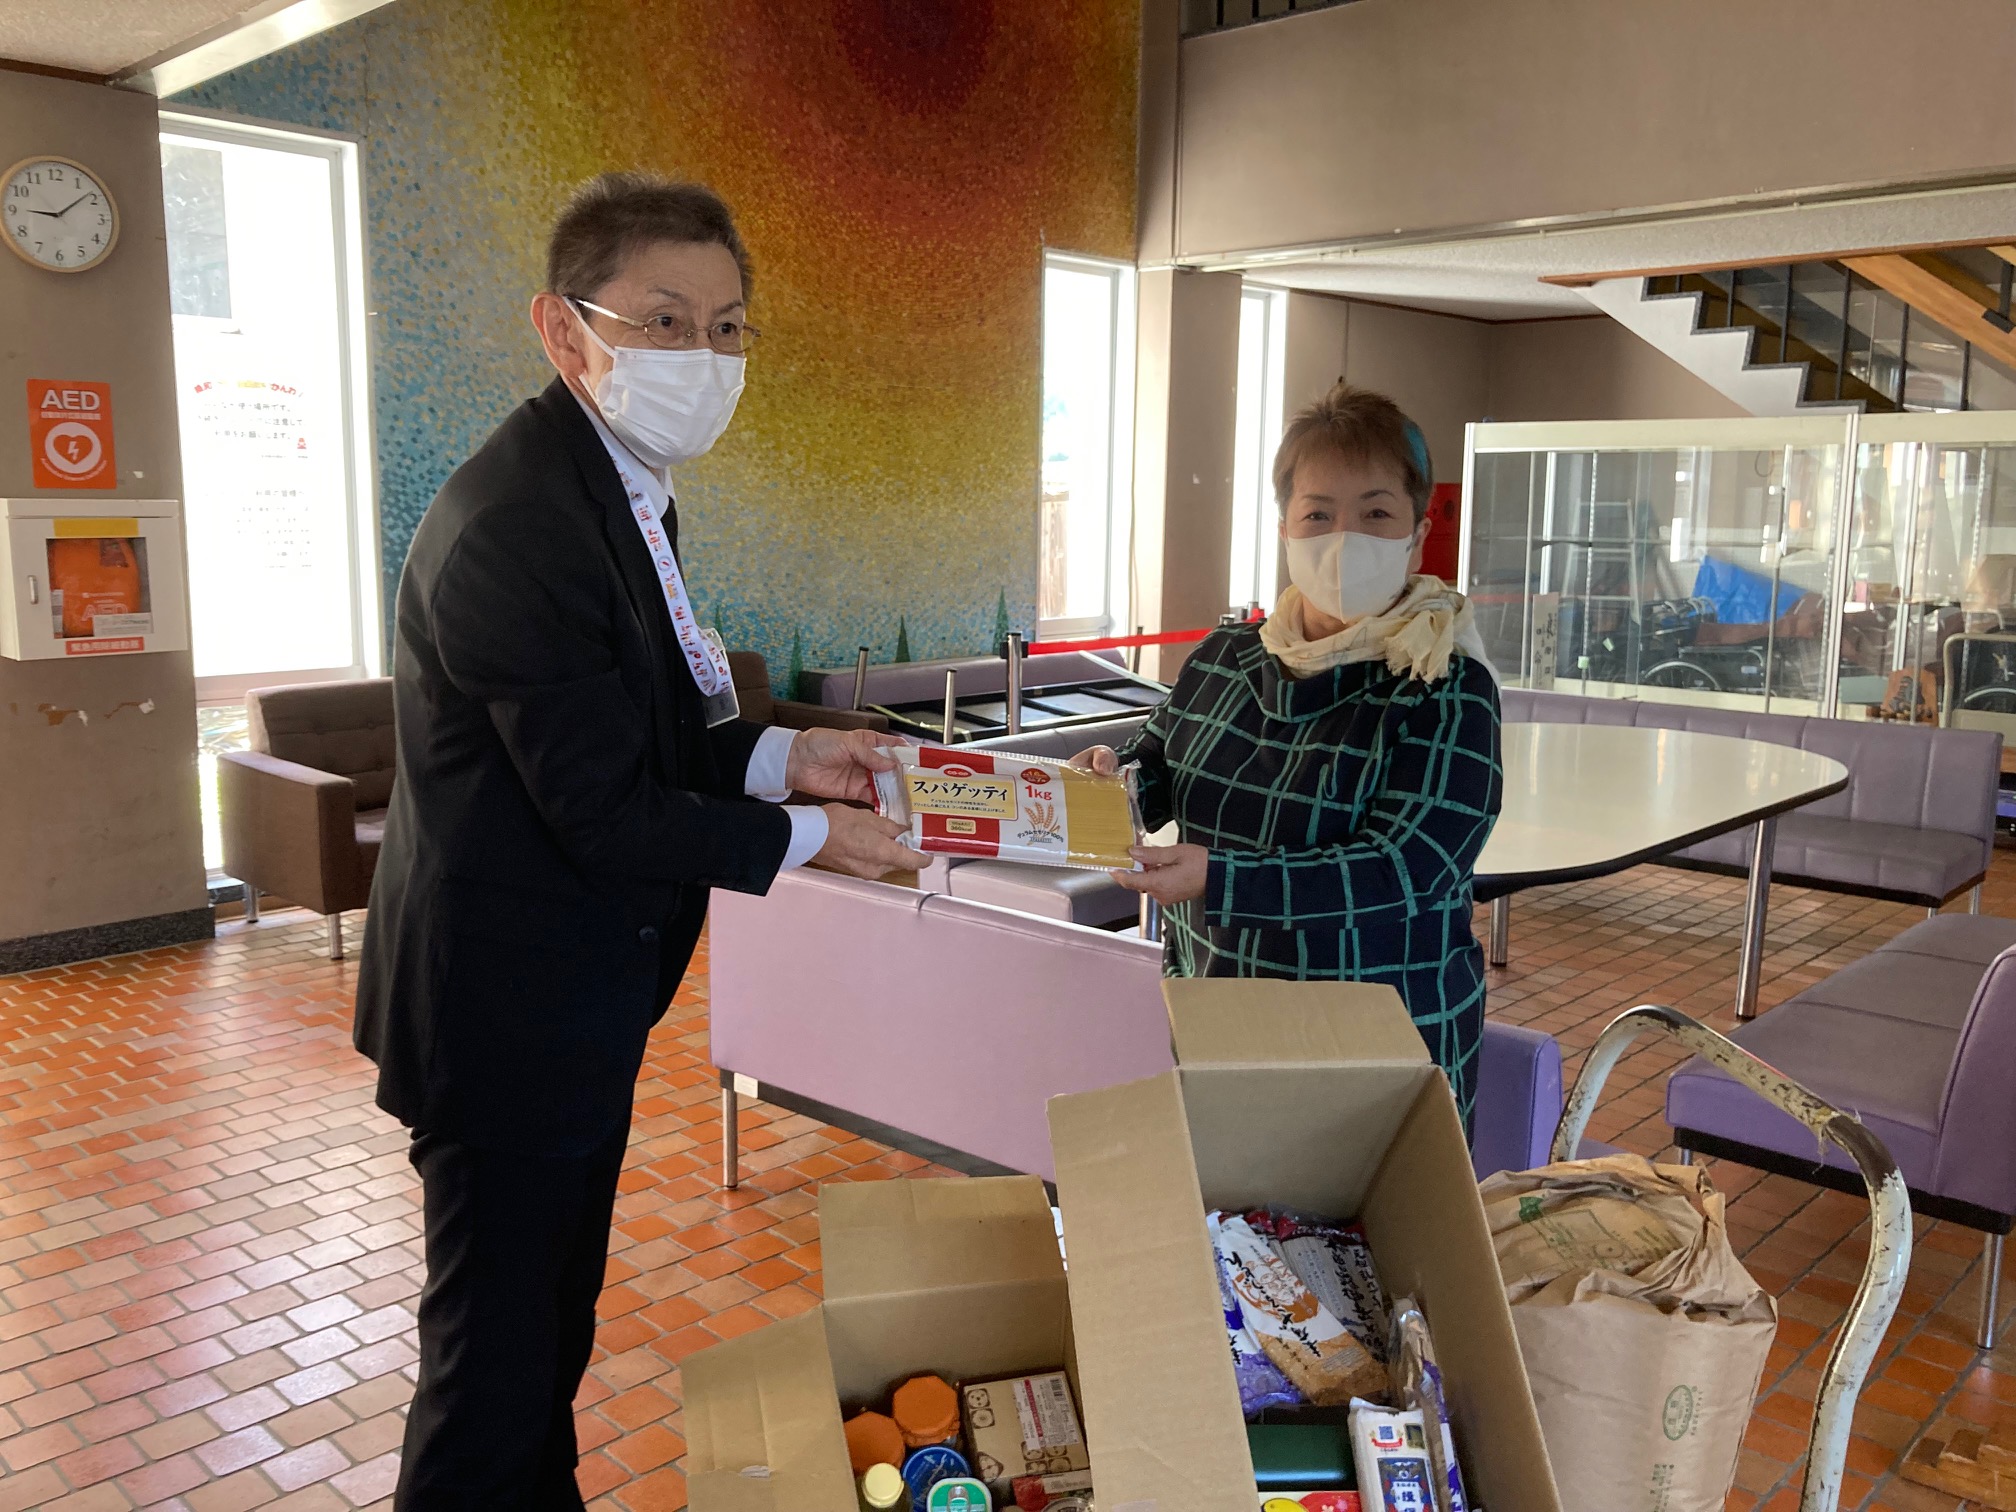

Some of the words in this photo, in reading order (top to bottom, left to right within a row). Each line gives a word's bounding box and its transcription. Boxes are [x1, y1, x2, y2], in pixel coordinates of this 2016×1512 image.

[25, 171, 41, 185] 11
[47, 168, 63, 182] 12
[74, 177, 82, 190] 1
[12, 184, 30, 198] 10
[89, 193, 98, 206] 2
[8, 204, 18, 216] 9
[97, 213, 106, 226] 3
[17, 224, 28, 238] 8
[91, 233, 100, 245] 4
[34, 241, 44, 253] 7
[77, 245, 86, 258] 5
[55, 249, 64, 262] 6
[40, 389, 100, 411] AED
[912, 780, 1008, 801] スパゲッティ
[1025, 785, 1053, 800] 1kg
